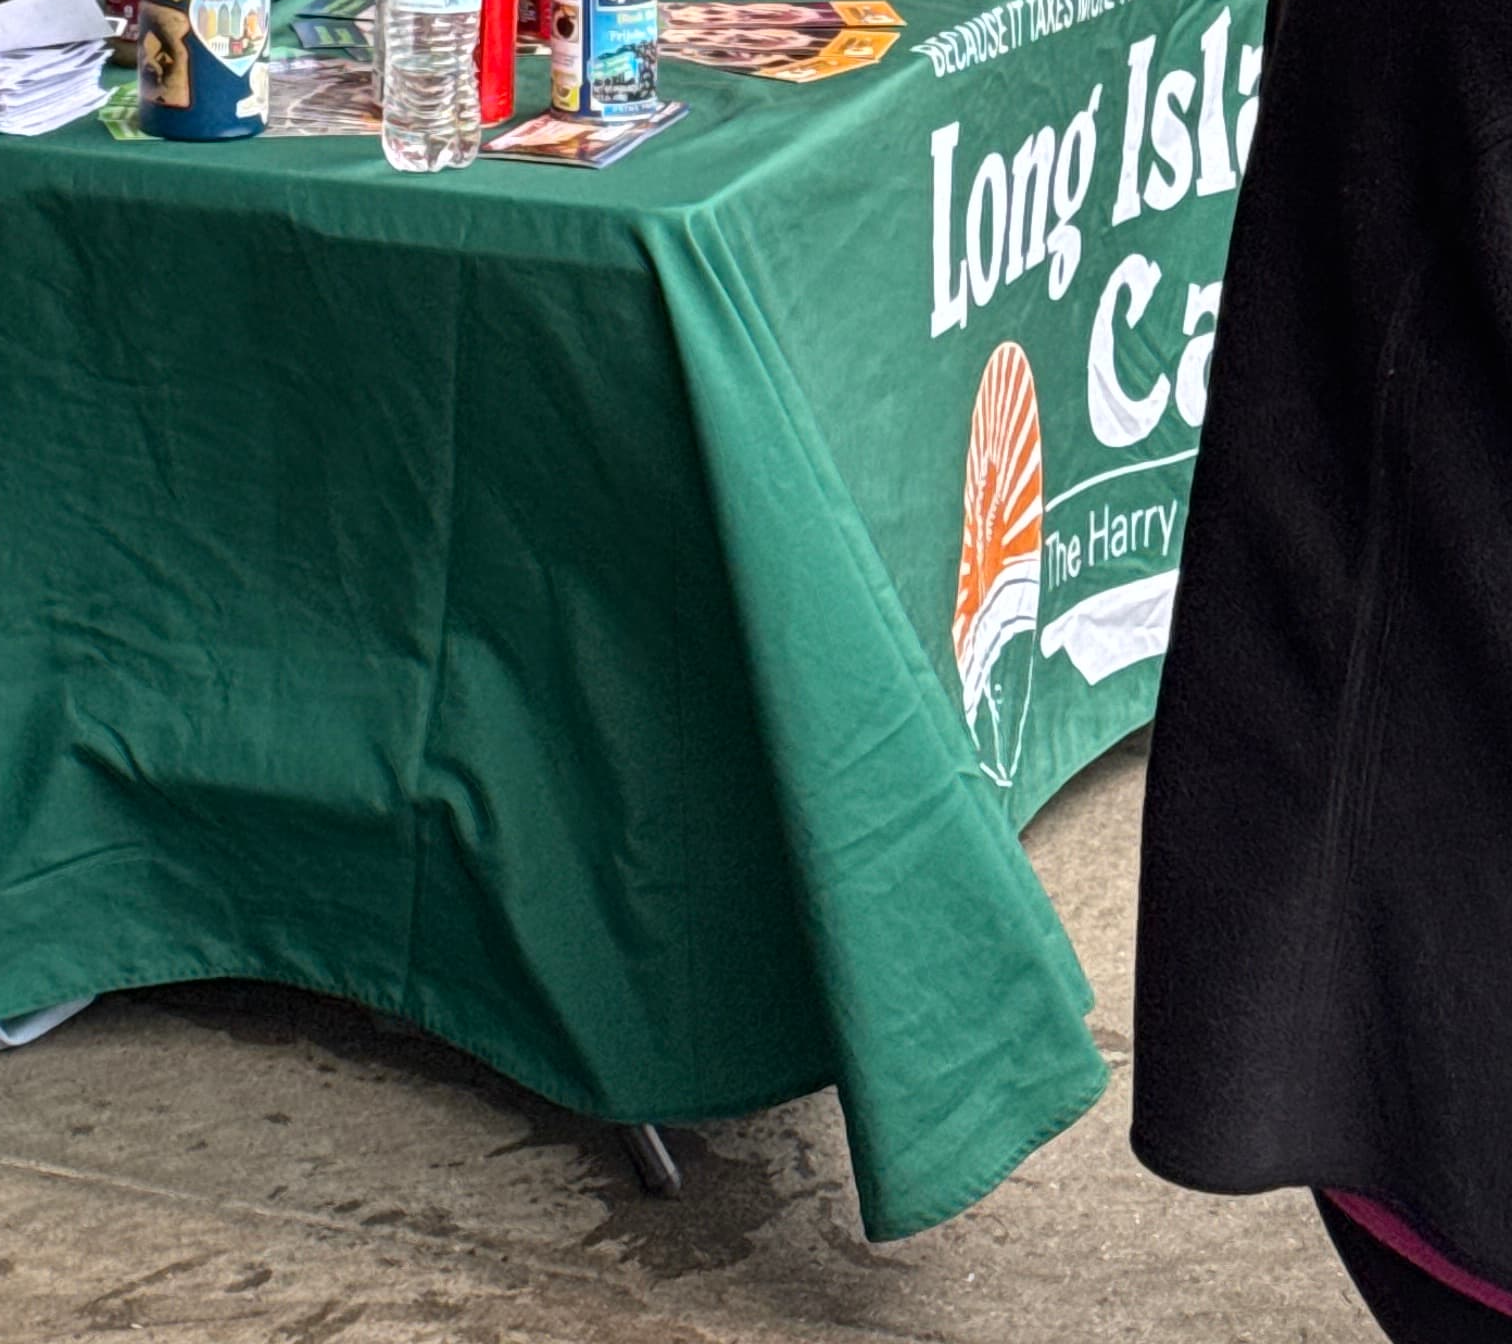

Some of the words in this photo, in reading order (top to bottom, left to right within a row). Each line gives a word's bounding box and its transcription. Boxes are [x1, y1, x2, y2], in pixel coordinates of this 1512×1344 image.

[910, 4, 1010, 78] BECAUSE
[1008, 0, 1024, 48] IT
[930, 83, 1103, 339] Long
[1045, 531, 1081, 592] The
[1089, 499, 1178, 567] Harry
